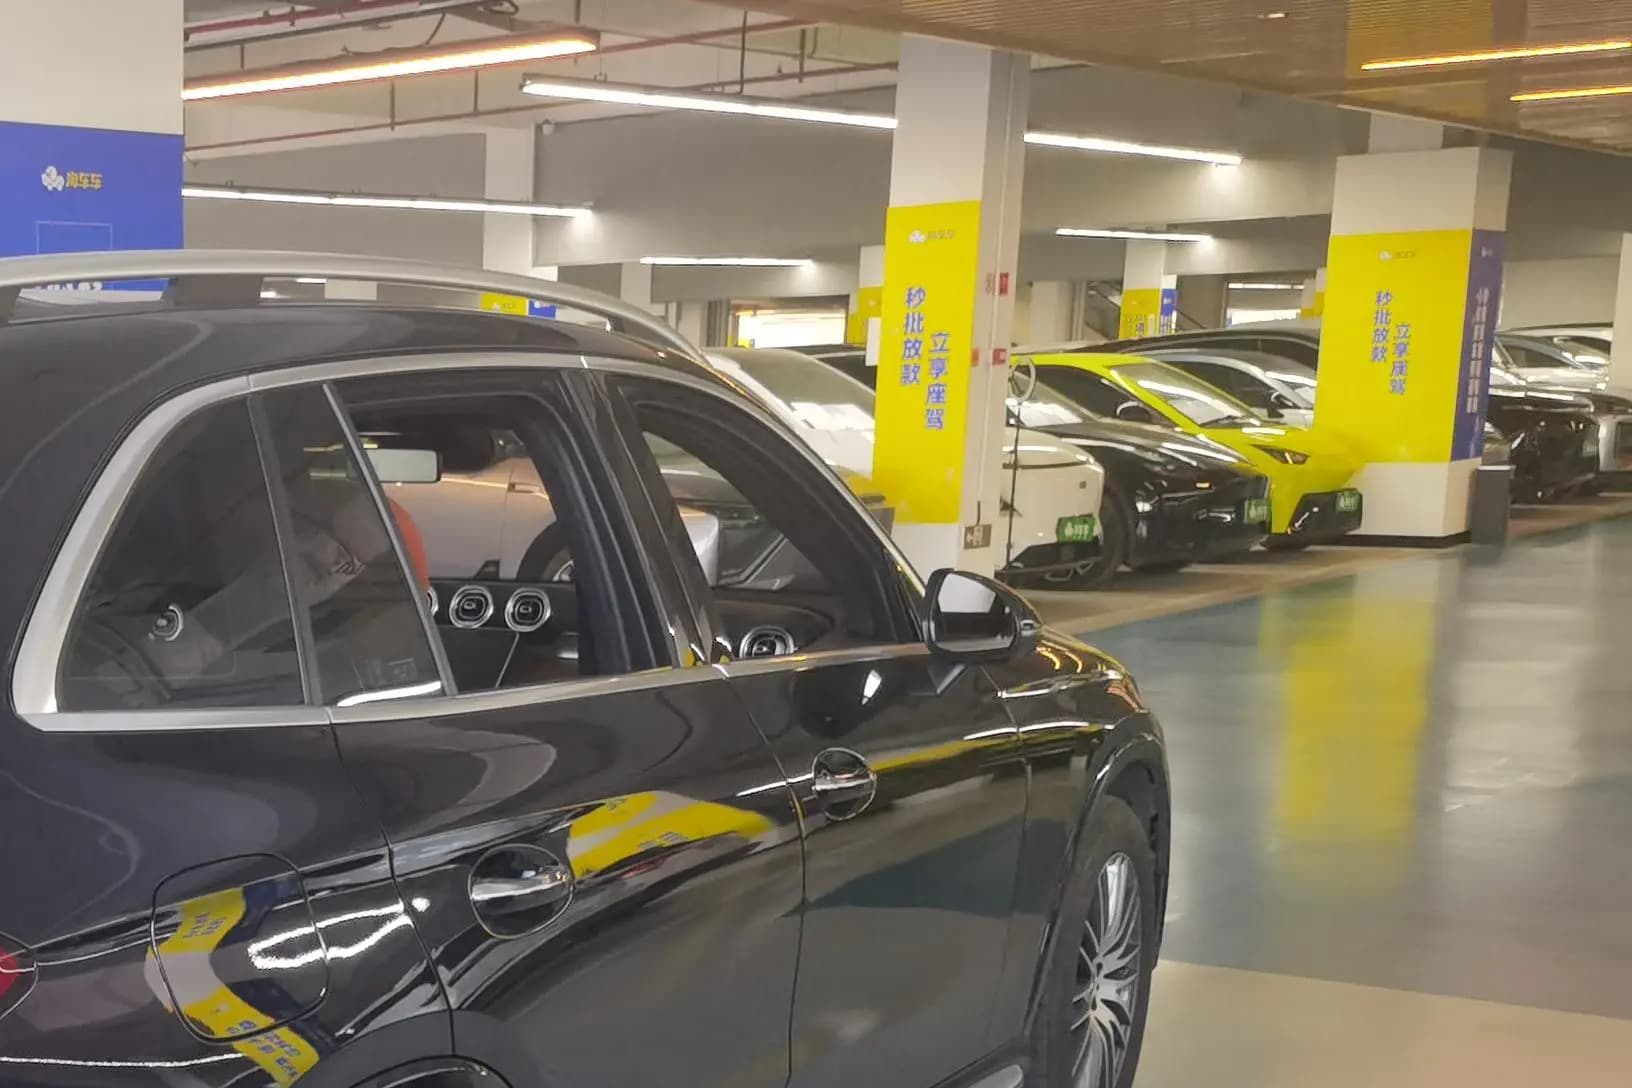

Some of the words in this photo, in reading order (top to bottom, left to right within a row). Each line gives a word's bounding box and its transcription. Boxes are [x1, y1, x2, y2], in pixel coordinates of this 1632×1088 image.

[900, 286, 926, 387] 秒批放款
[924, 332, 951, 430] 立享座驾
